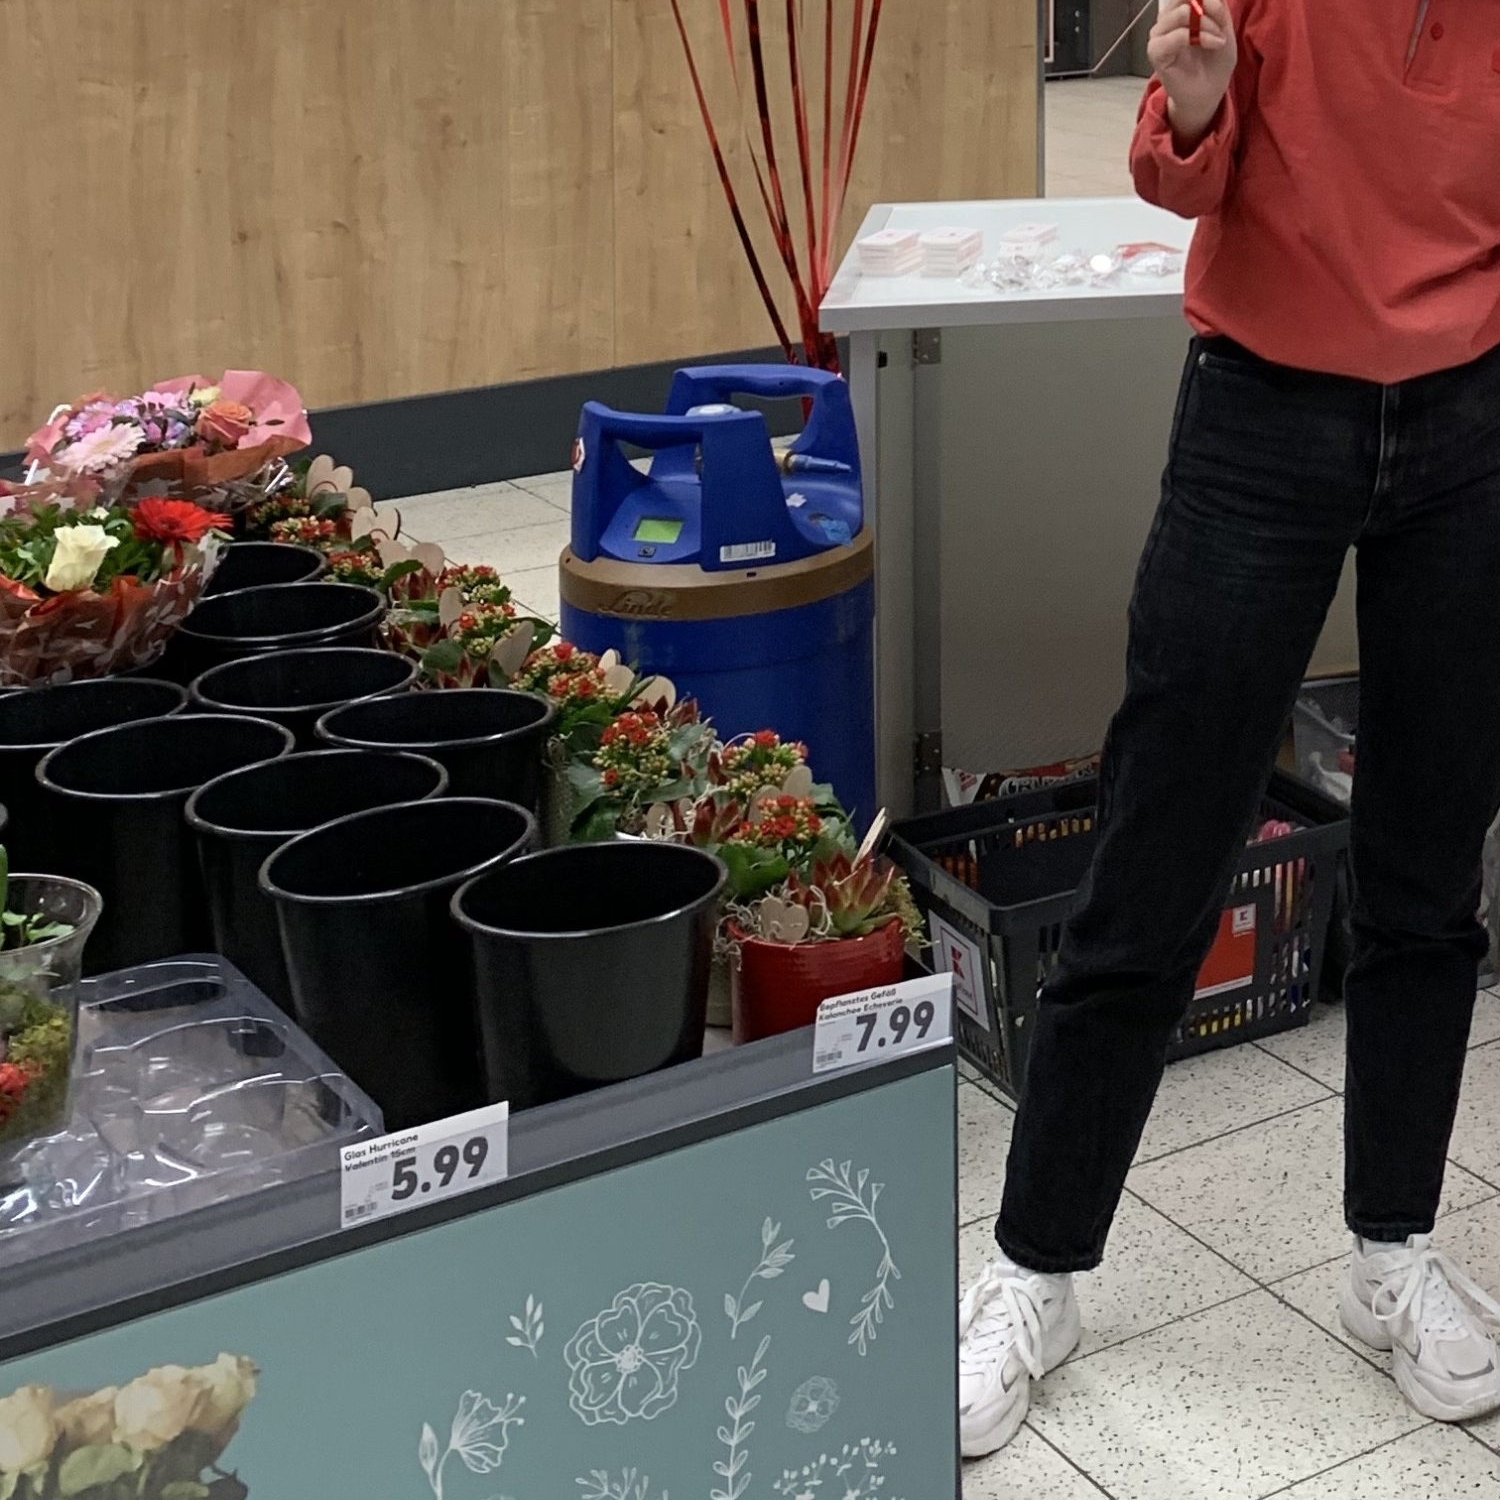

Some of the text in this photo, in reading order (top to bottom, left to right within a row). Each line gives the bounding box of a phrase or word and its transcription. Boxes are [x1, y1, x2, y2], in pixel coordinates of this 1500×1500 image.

[819, 988, 896, 1012] Bepflanztes Gefäß
[855, 1000, 935, 1053] 7.99
[344, 1134, 419, 1162] Glas Hurricane
[344, 1153, 388, 1172] Valentin
[391, 1135, 489, 1201] 5.99
